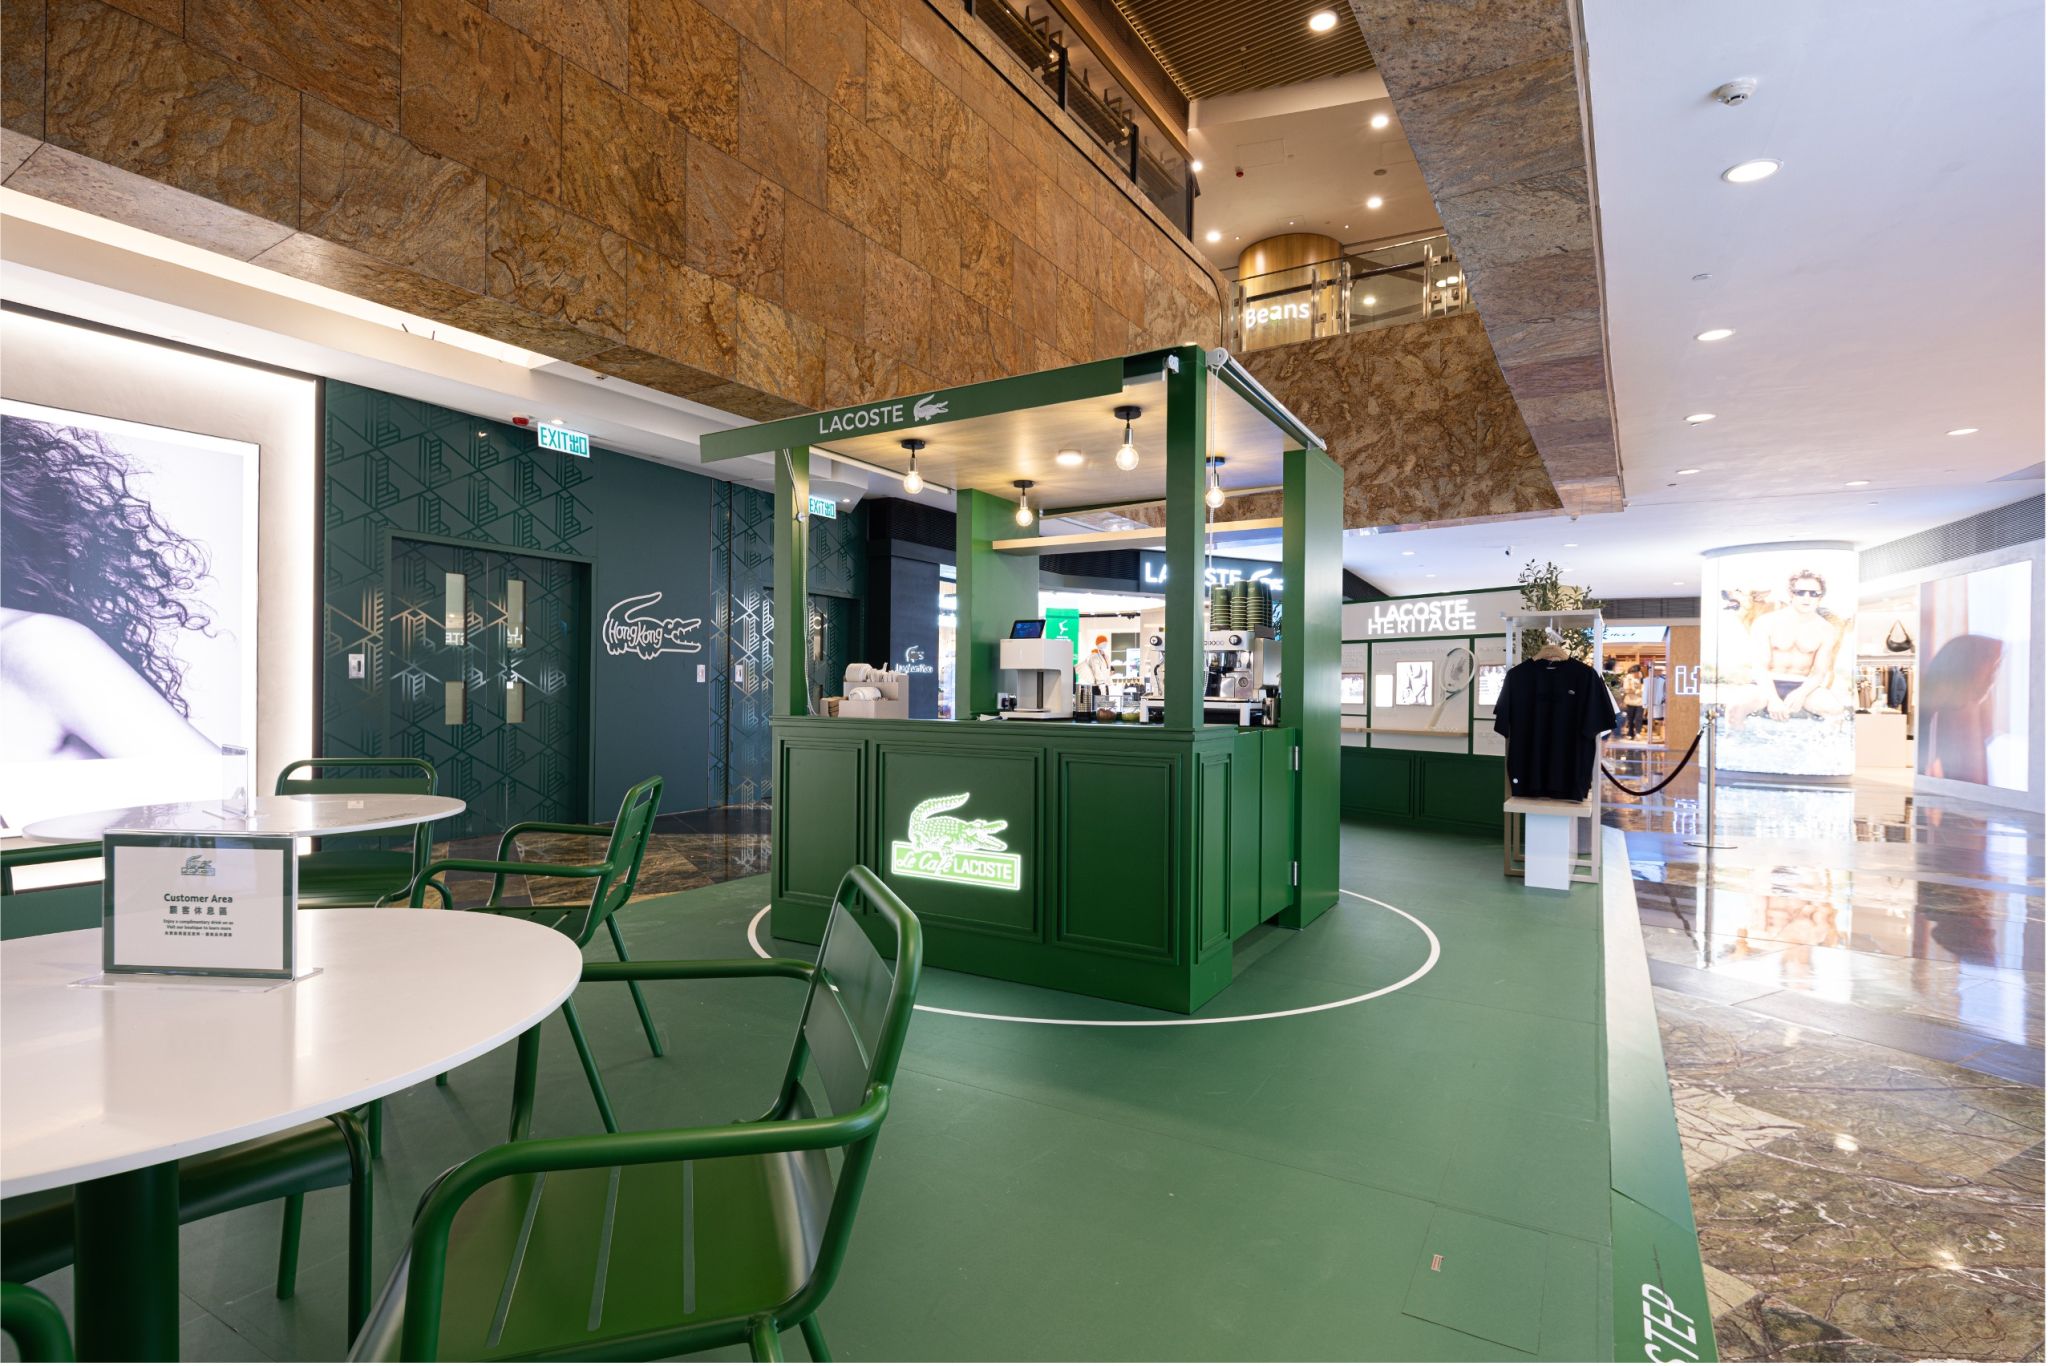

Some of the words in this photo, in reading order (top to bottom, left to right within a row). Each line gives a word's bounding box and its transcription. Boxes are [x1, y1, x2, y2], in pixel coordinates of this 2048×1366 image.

[1246, 303, 1310, 328] Beans
[819, 404, 904, 434] LACOSTE
[540, 426, 569, 450] EXIT
[569, 434, 588, 456] 出口
[809, 498, 824, 515] EXIT
[1374, 598, 1469, 622] LACOSTE
[1367, 611, 1476, 635] HERITAGE
[897, 852, 915, 868] Le
[954, 857, 1012, 880] LACOSTE
[164, 893, 208, 902] Customer
[211, 895, 233, 903] Area
